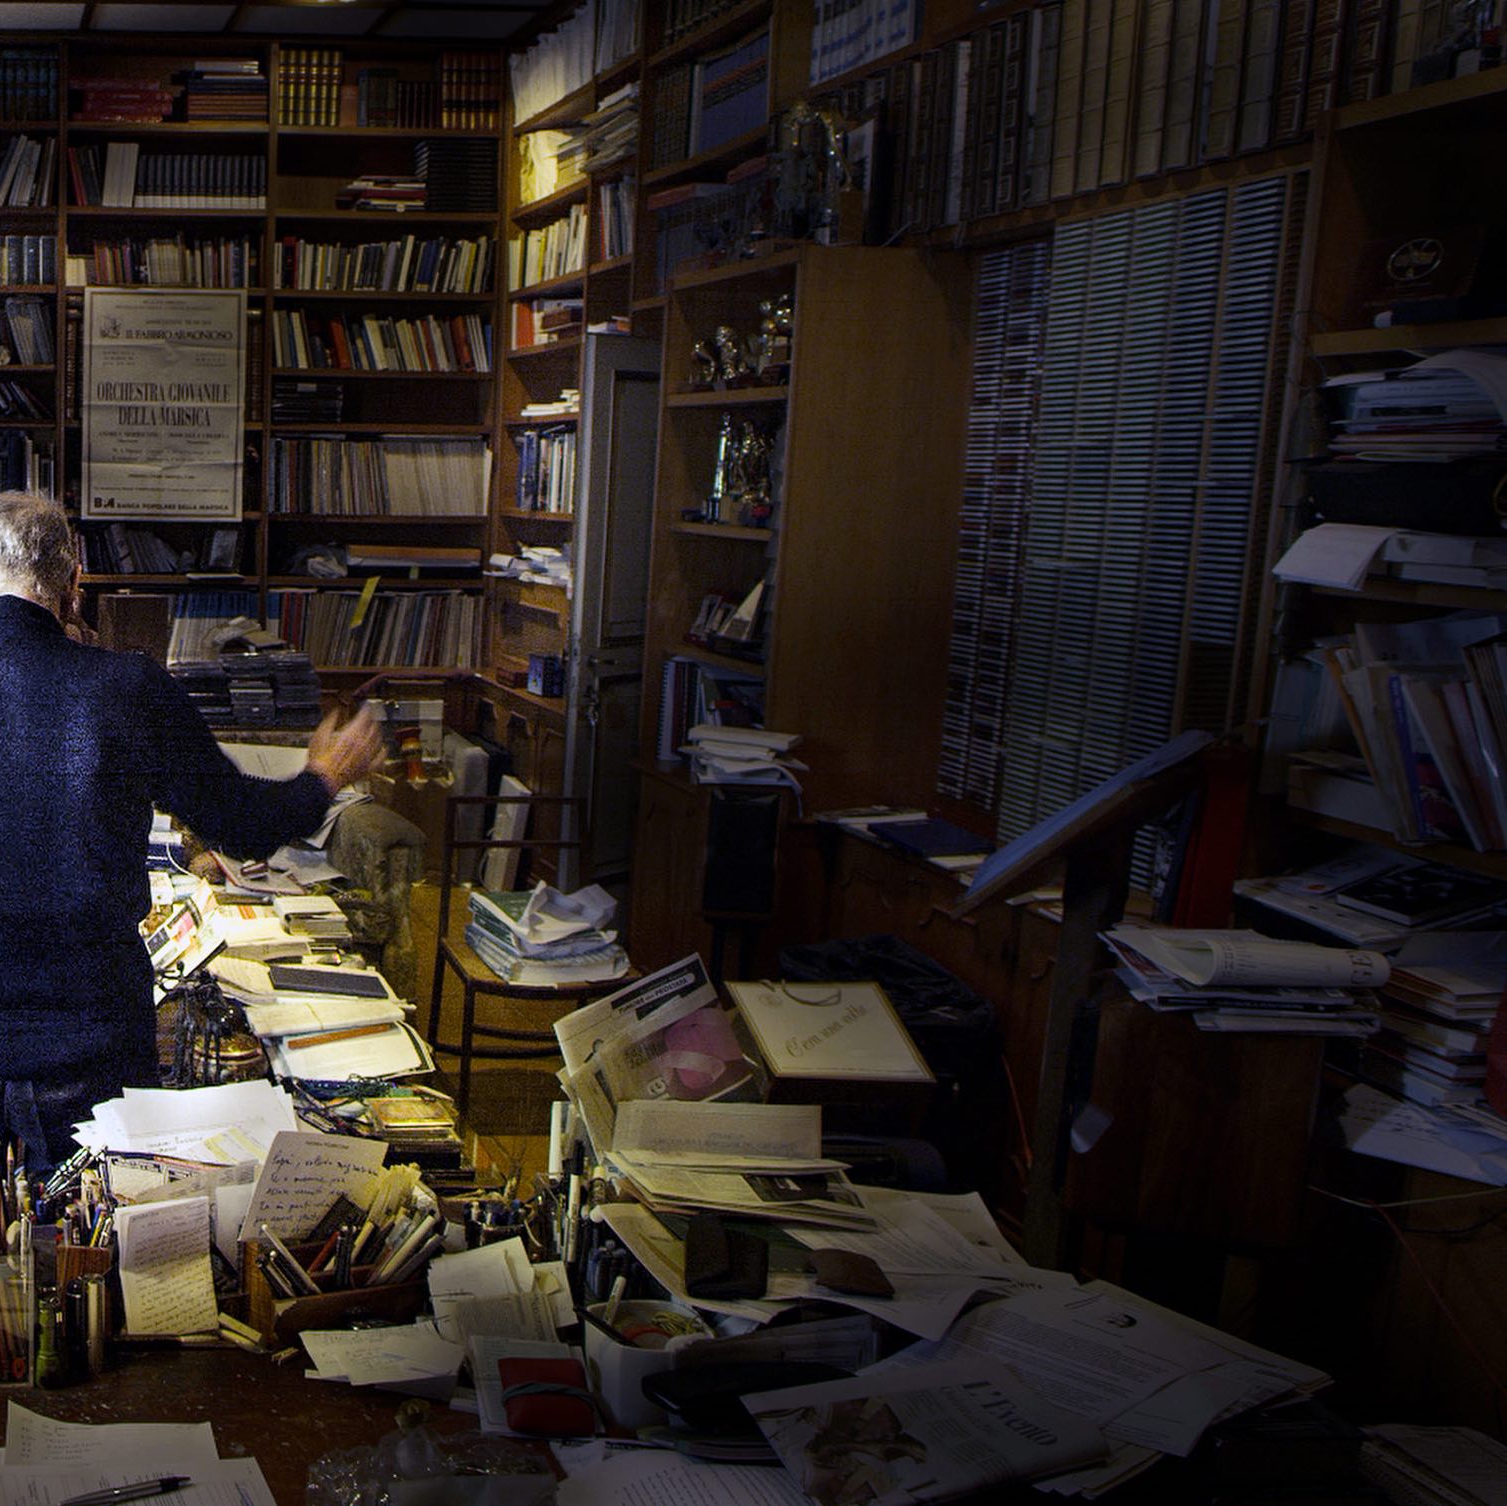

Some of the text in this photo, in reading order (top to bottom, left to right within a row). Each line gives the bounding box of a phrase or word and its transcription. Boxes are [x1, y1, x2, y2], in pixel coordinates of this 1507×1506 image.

[97, 382, 231, 402] ORCHESTRA GIOVANILE
[118, 407, 211, 427] DELLA MARSICA
